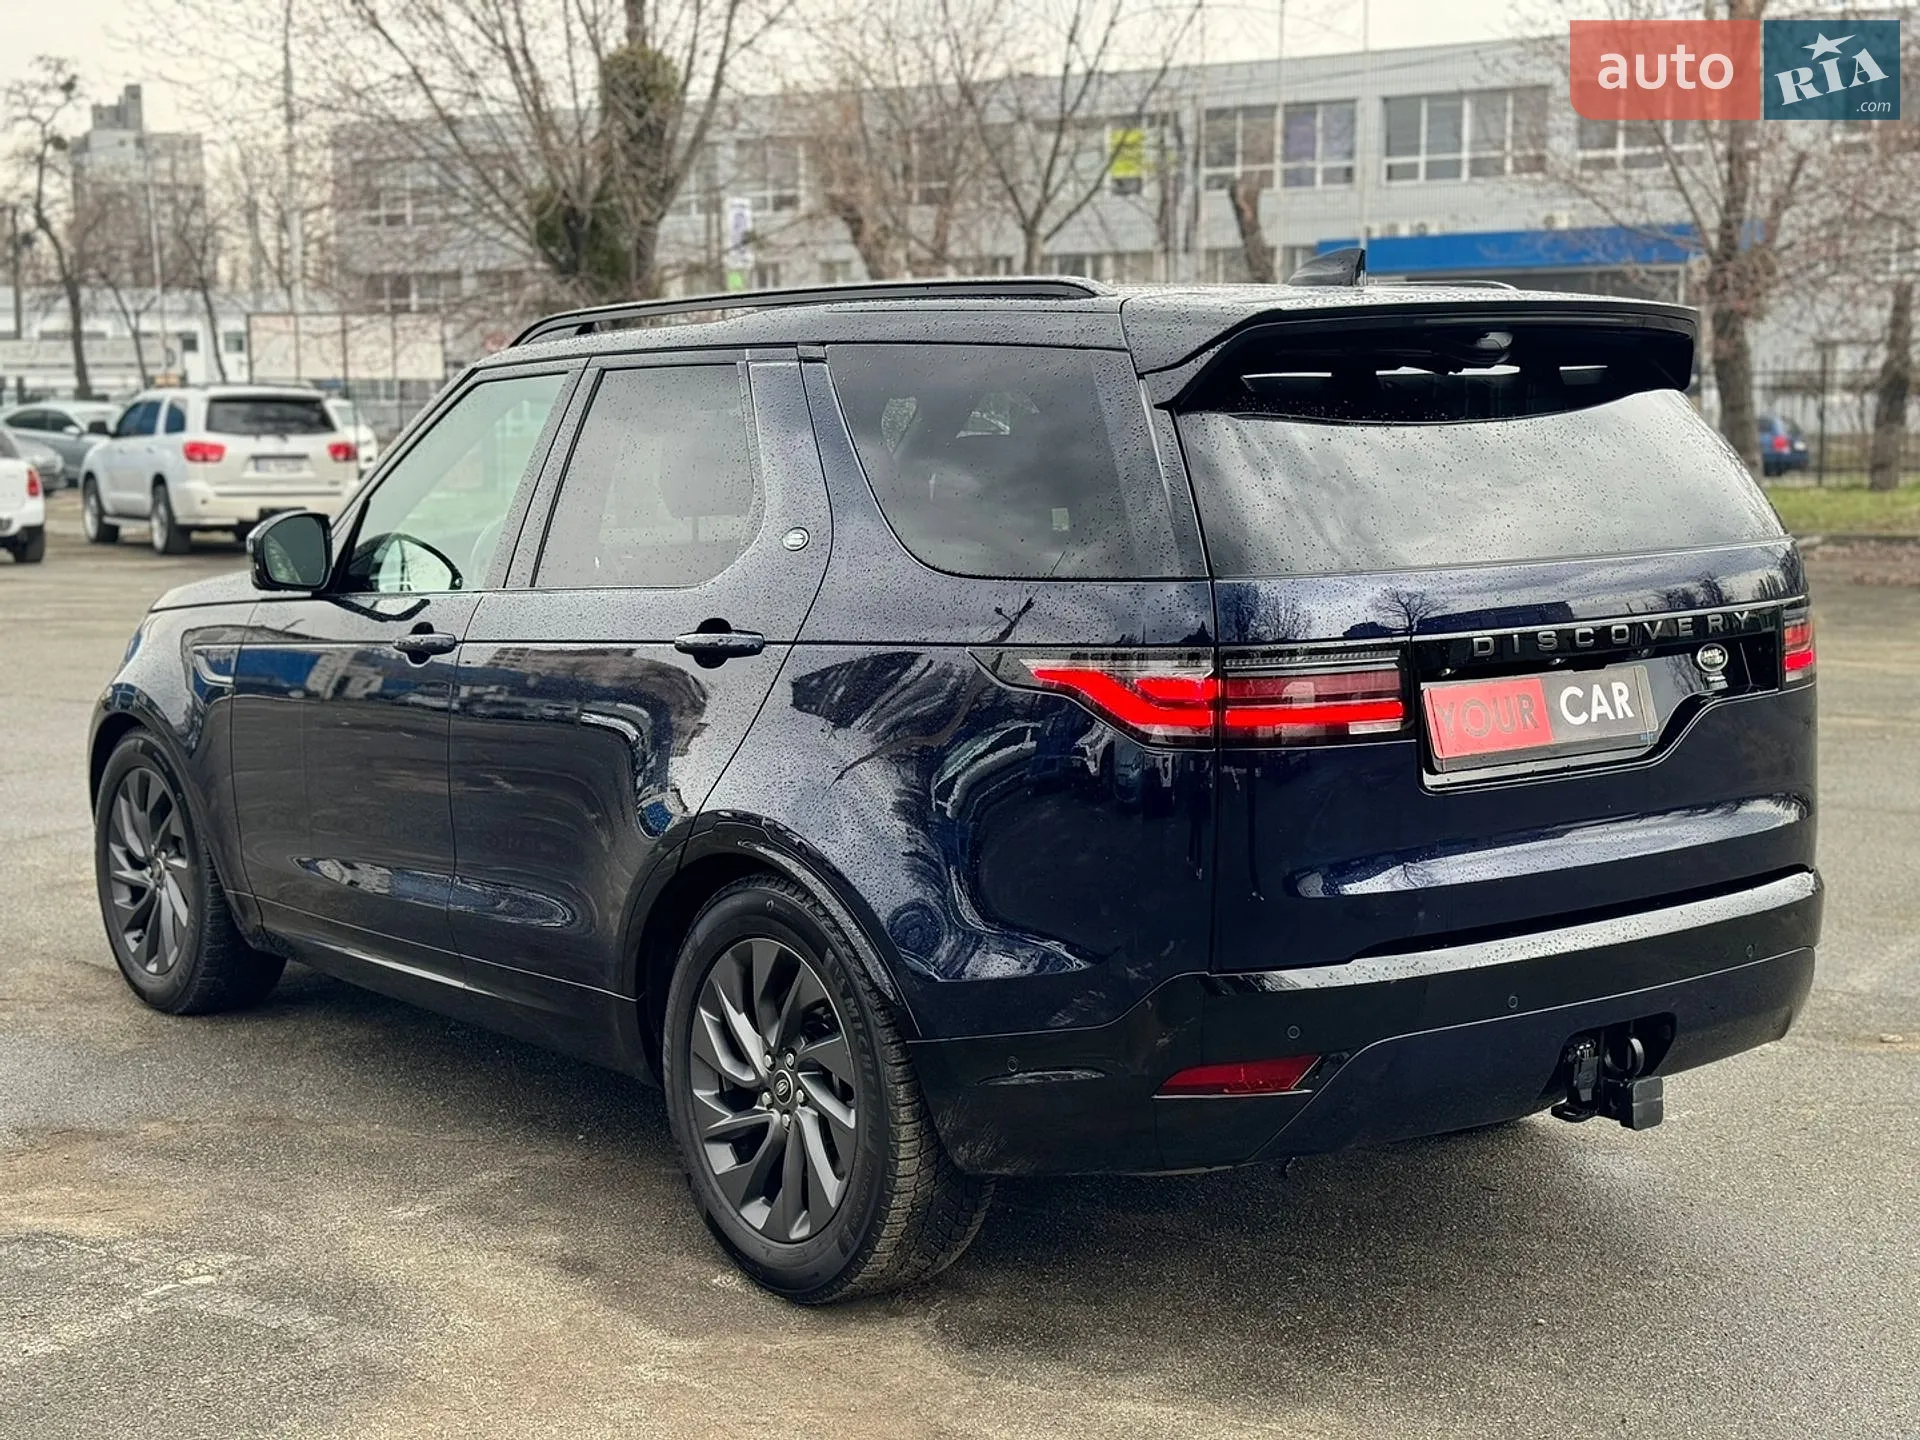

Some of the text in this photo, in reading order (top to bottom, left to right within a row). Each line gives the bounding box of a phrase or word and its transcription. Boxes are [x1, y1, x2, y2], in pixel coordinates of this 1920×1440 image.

[1472, 610, 1751, 657] DISCOVERY
[1435, 681, 1635, 738] YOUR CAR
